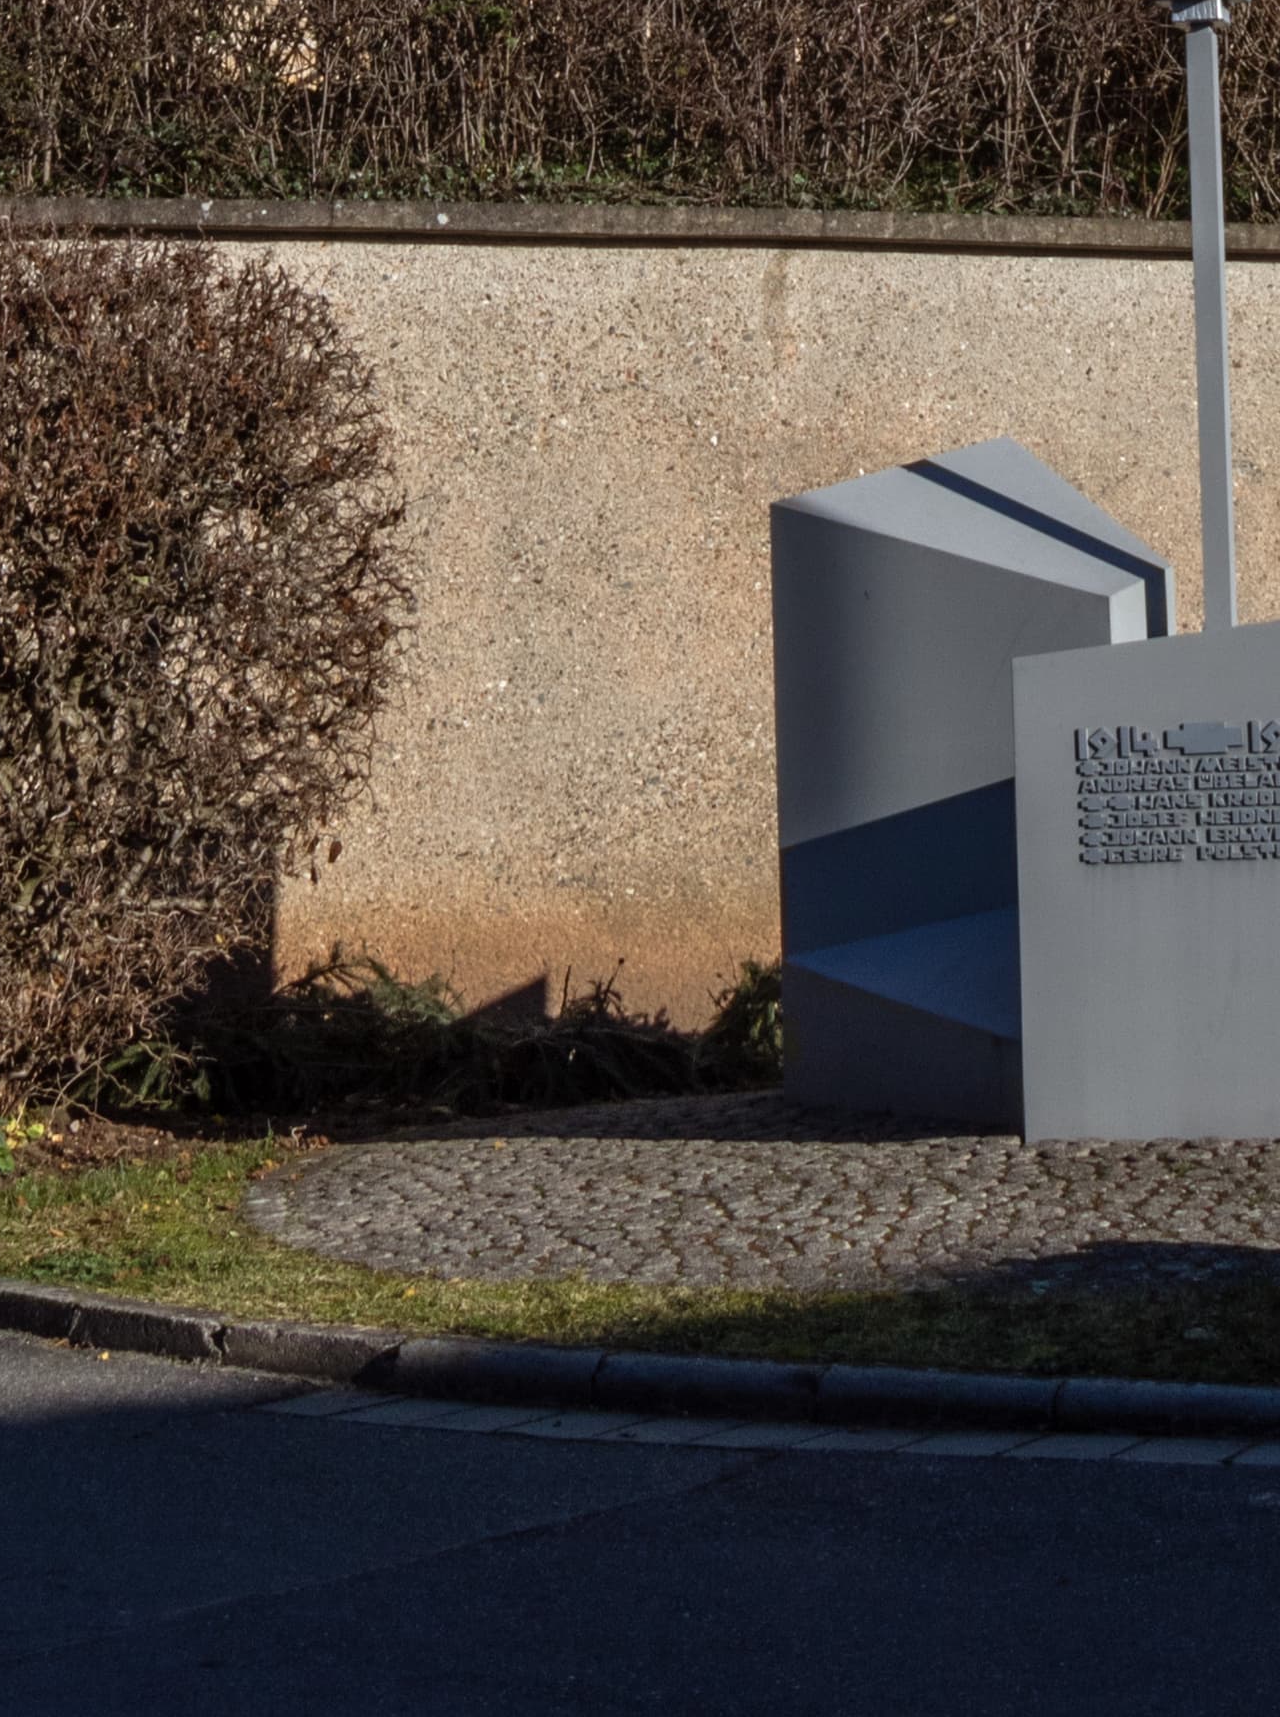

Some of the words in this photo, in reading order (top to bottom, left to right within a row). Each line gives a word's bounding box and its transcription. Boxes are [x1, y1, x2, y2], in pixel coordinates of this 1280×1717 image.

[1074, 726, 1160, 761] 1914
[1099, 759, 1194, 775] JOHANN
[1078, 776, 1191, 794] ANDREAS
[1135, 792, 1202, 810] HANS
[1107, 811, 1187, 828] JOSEF
[1100, 829, 1199, 846] JOHANN
[1104, 846, 1185, 864] GEORG
